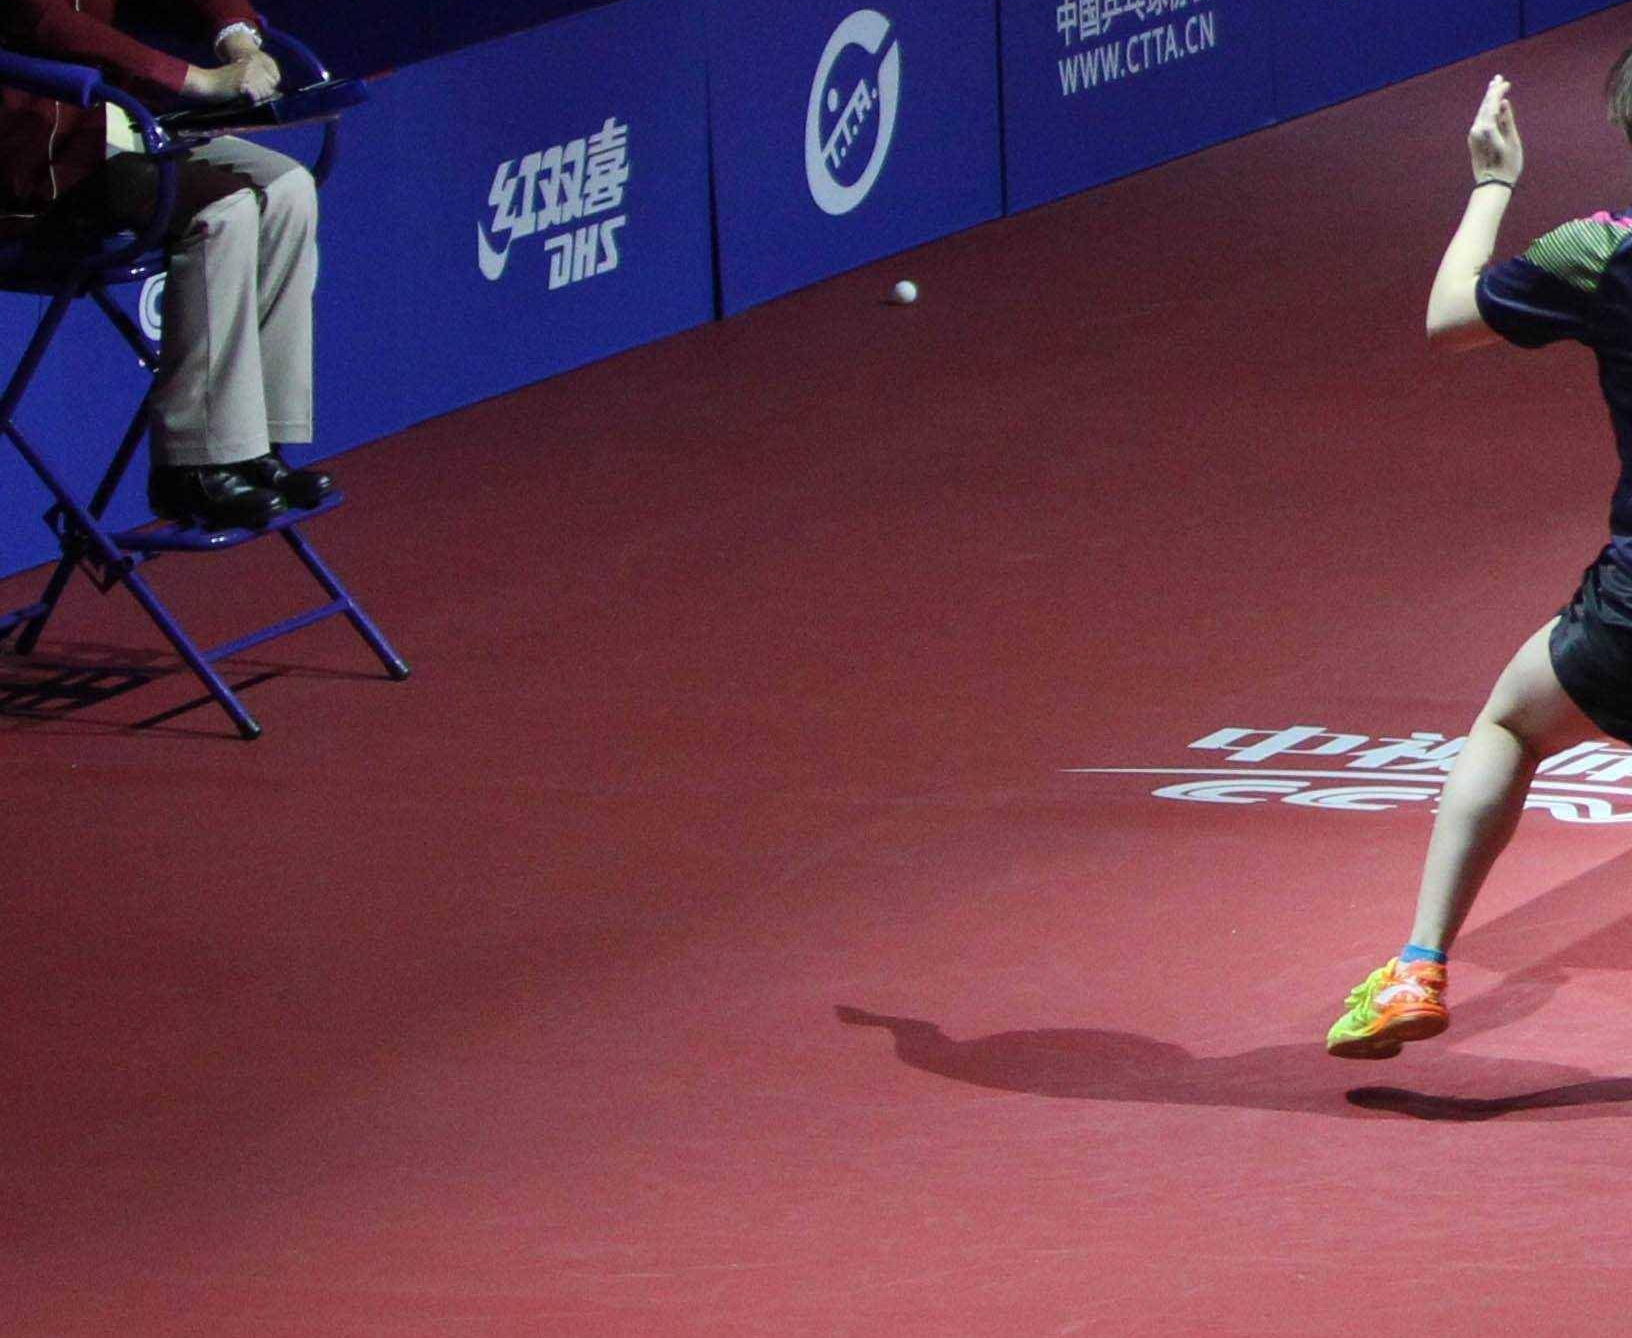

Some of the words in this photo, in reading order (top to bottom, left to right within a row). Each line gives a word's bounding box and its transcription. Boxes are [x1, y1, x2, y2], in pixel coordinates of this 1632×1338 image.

[1058, 10, 1216, 96] WWW.CTTA.CN
[477, 116, 630, 281] 红双喜
[543, 215, 627, 291] DHS
